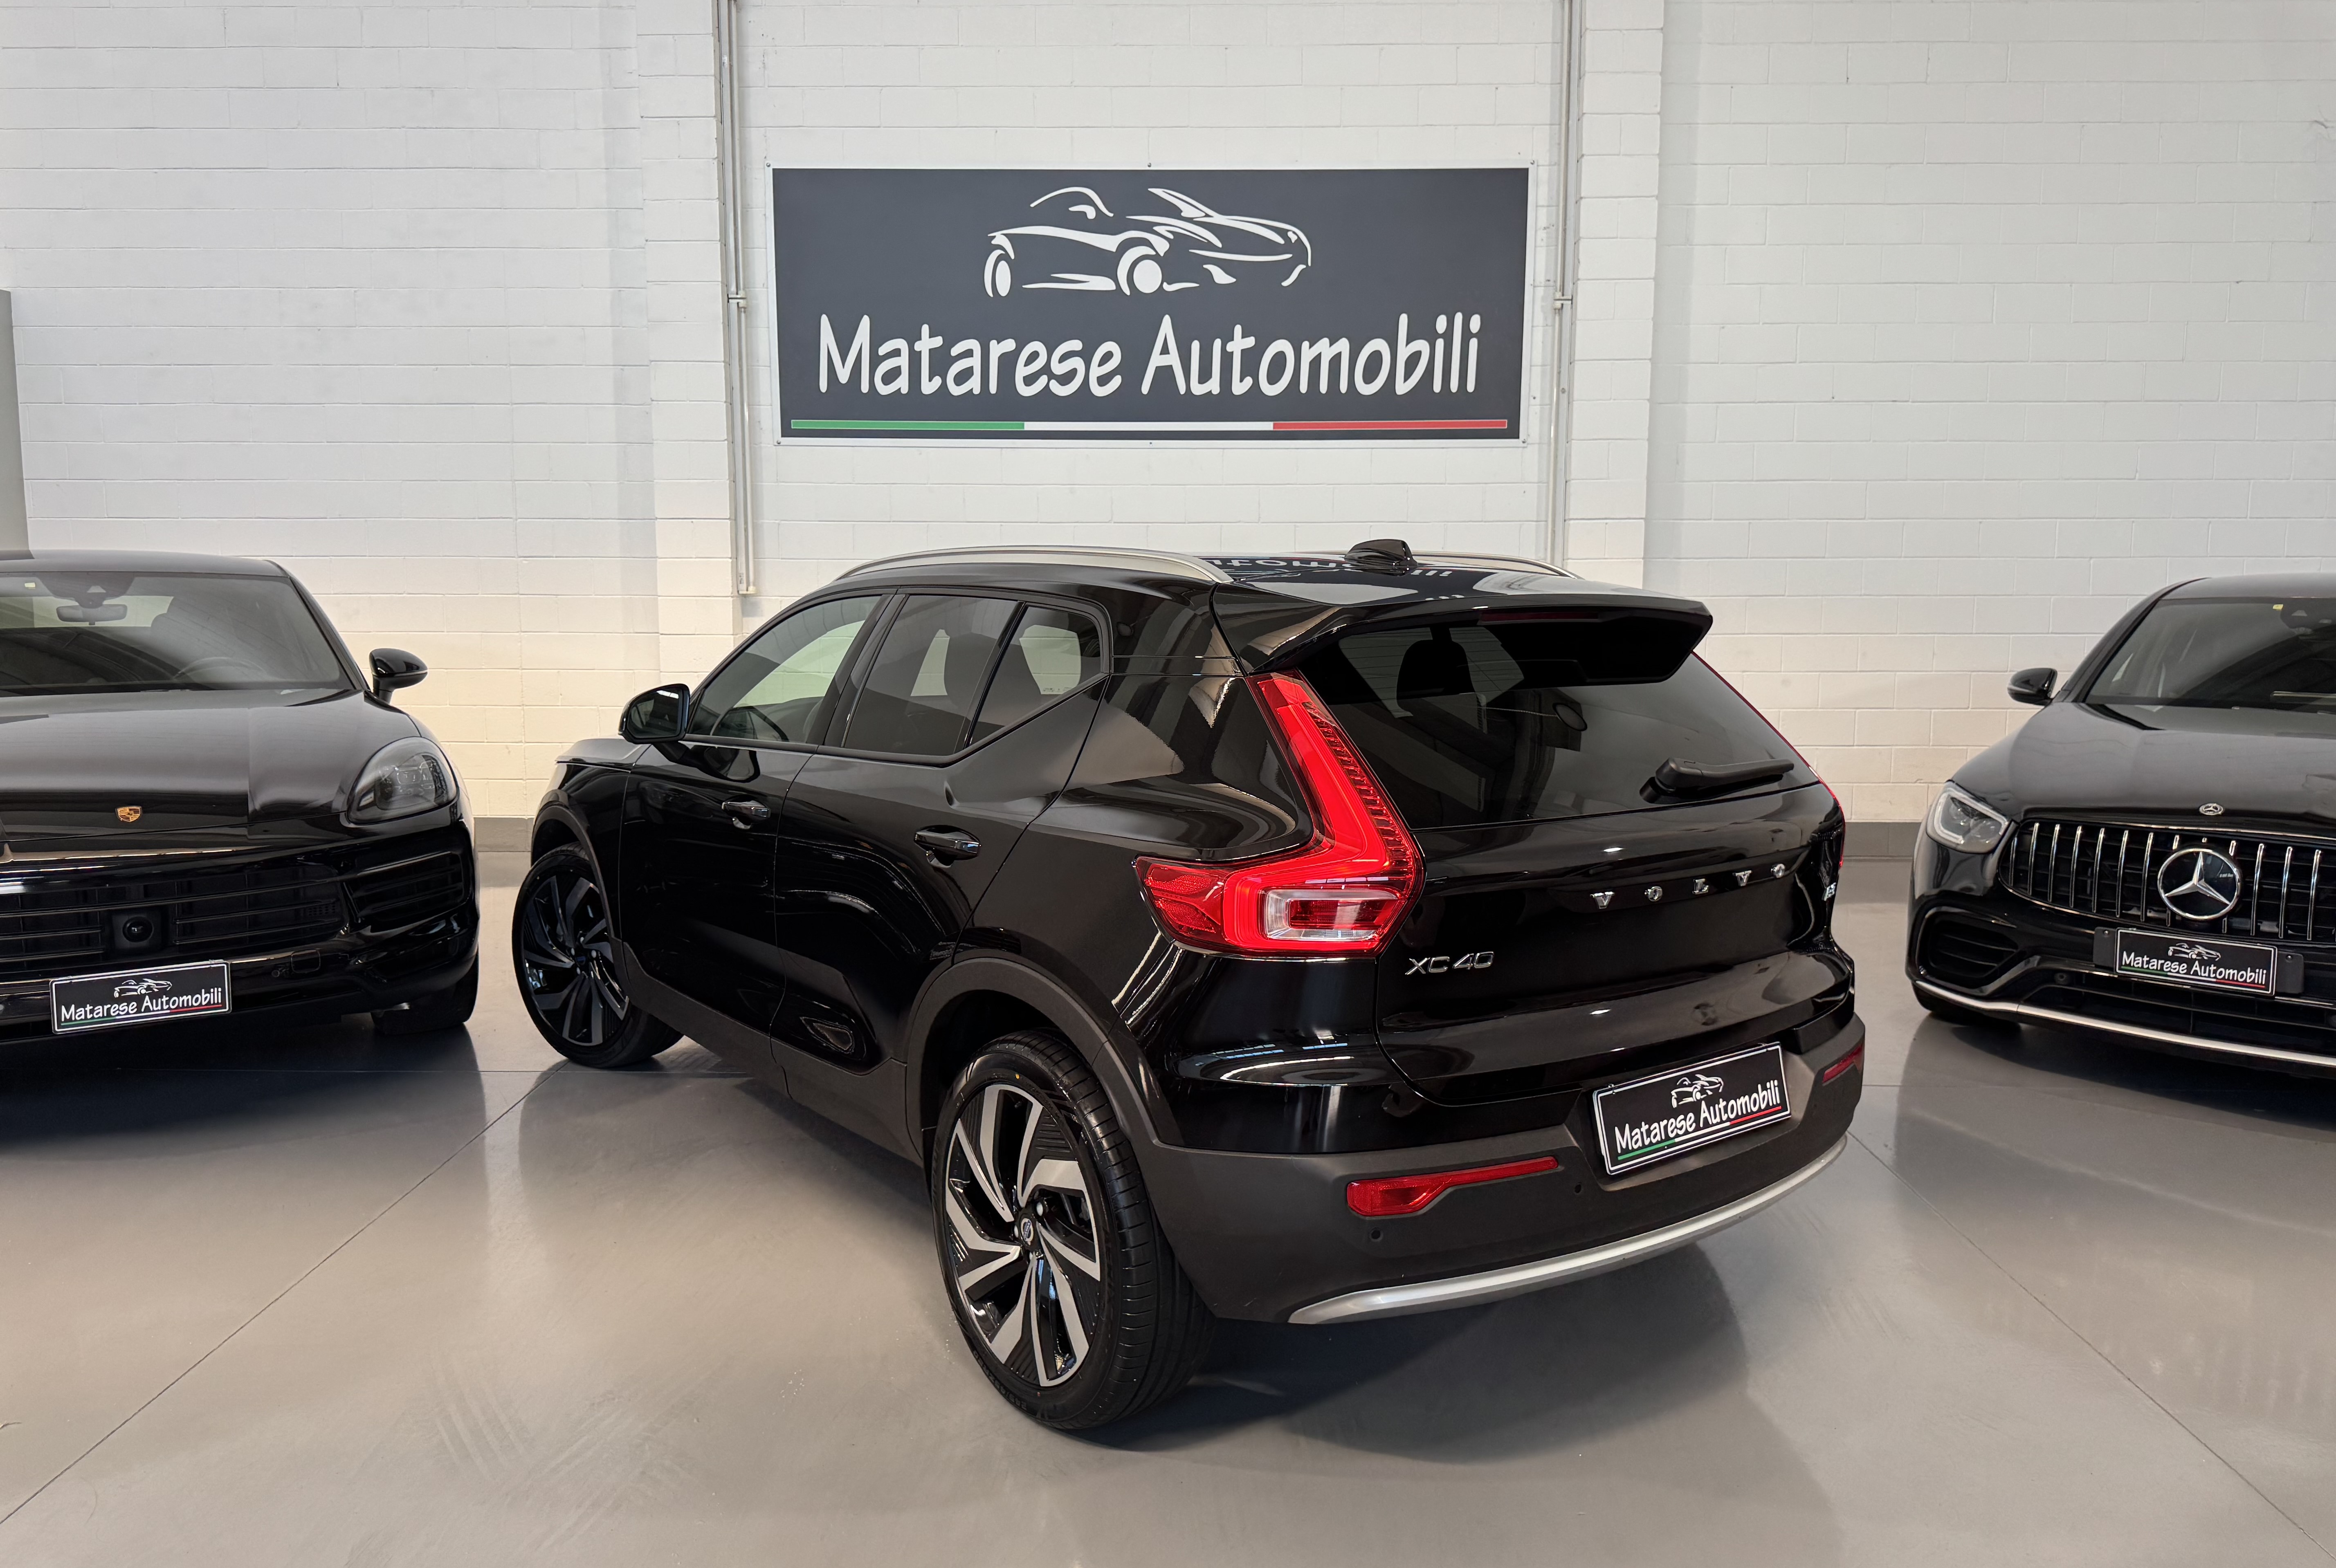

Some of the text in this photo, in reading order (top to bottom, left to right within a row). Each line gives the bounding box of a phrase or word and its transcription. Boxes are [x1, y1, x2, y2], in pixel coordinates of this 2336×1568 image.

[819, 312, 1481, 397] Matarese Automobili
[1590, 863, 1786, 909] VOLVO
[1404, 951, 1494, 975] XC40
[2122, 951, 2266, 985] Matarese Automobili
[61, 987, 222, 1022] Matarese Automobili
[1615, 1079, 1780, 1153] Matarese Automobili
